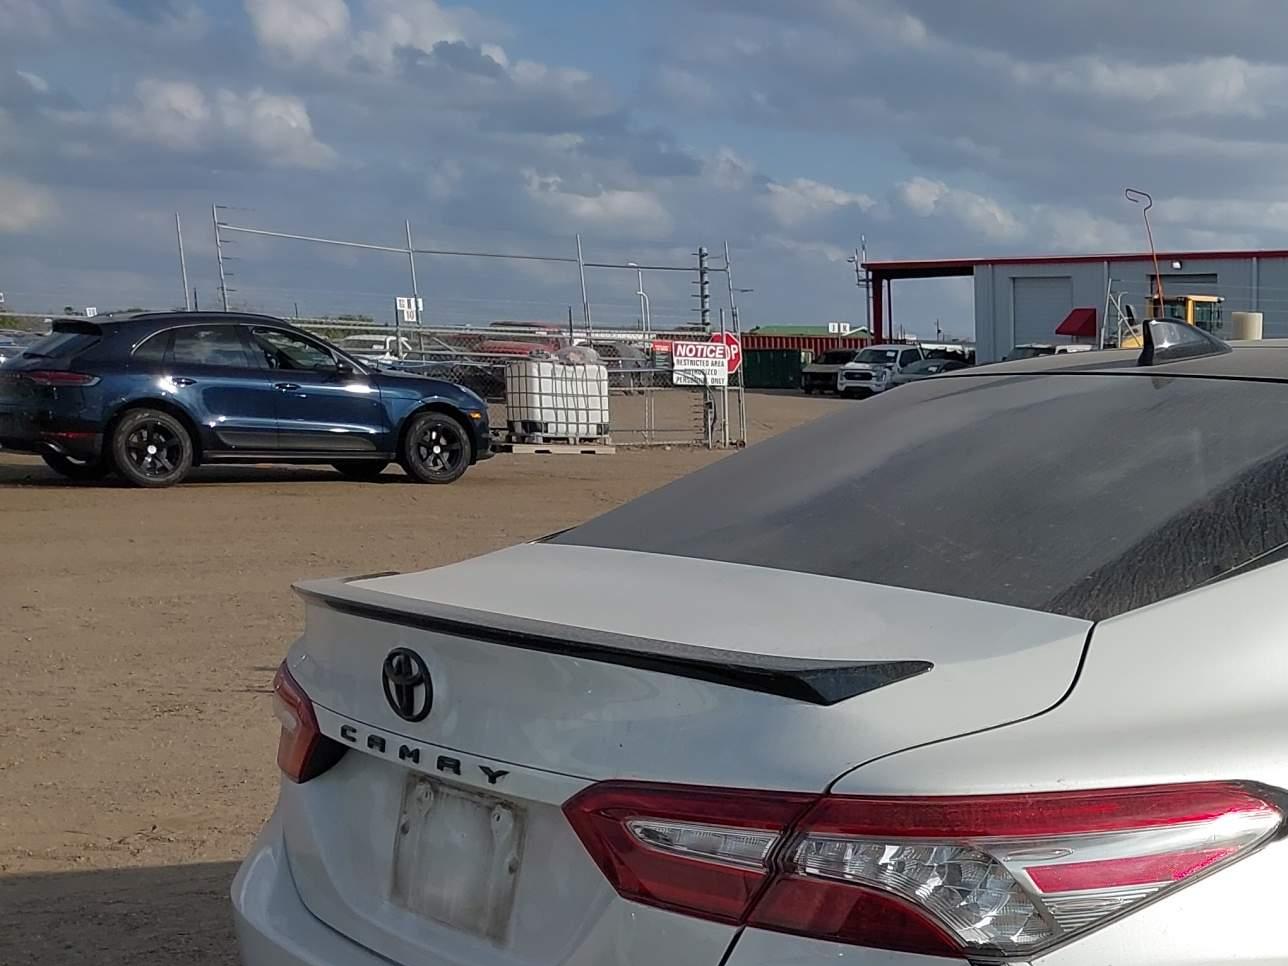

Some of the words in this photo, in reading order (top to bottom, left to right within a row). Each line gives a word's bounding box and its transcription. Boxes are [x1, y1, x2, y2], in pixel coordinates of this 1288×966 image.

[677, 344, 724, 358] NOTICE
[676, 359, 709, 367] RESTRICTED
[340, 724, 510, 785] CAMRY
